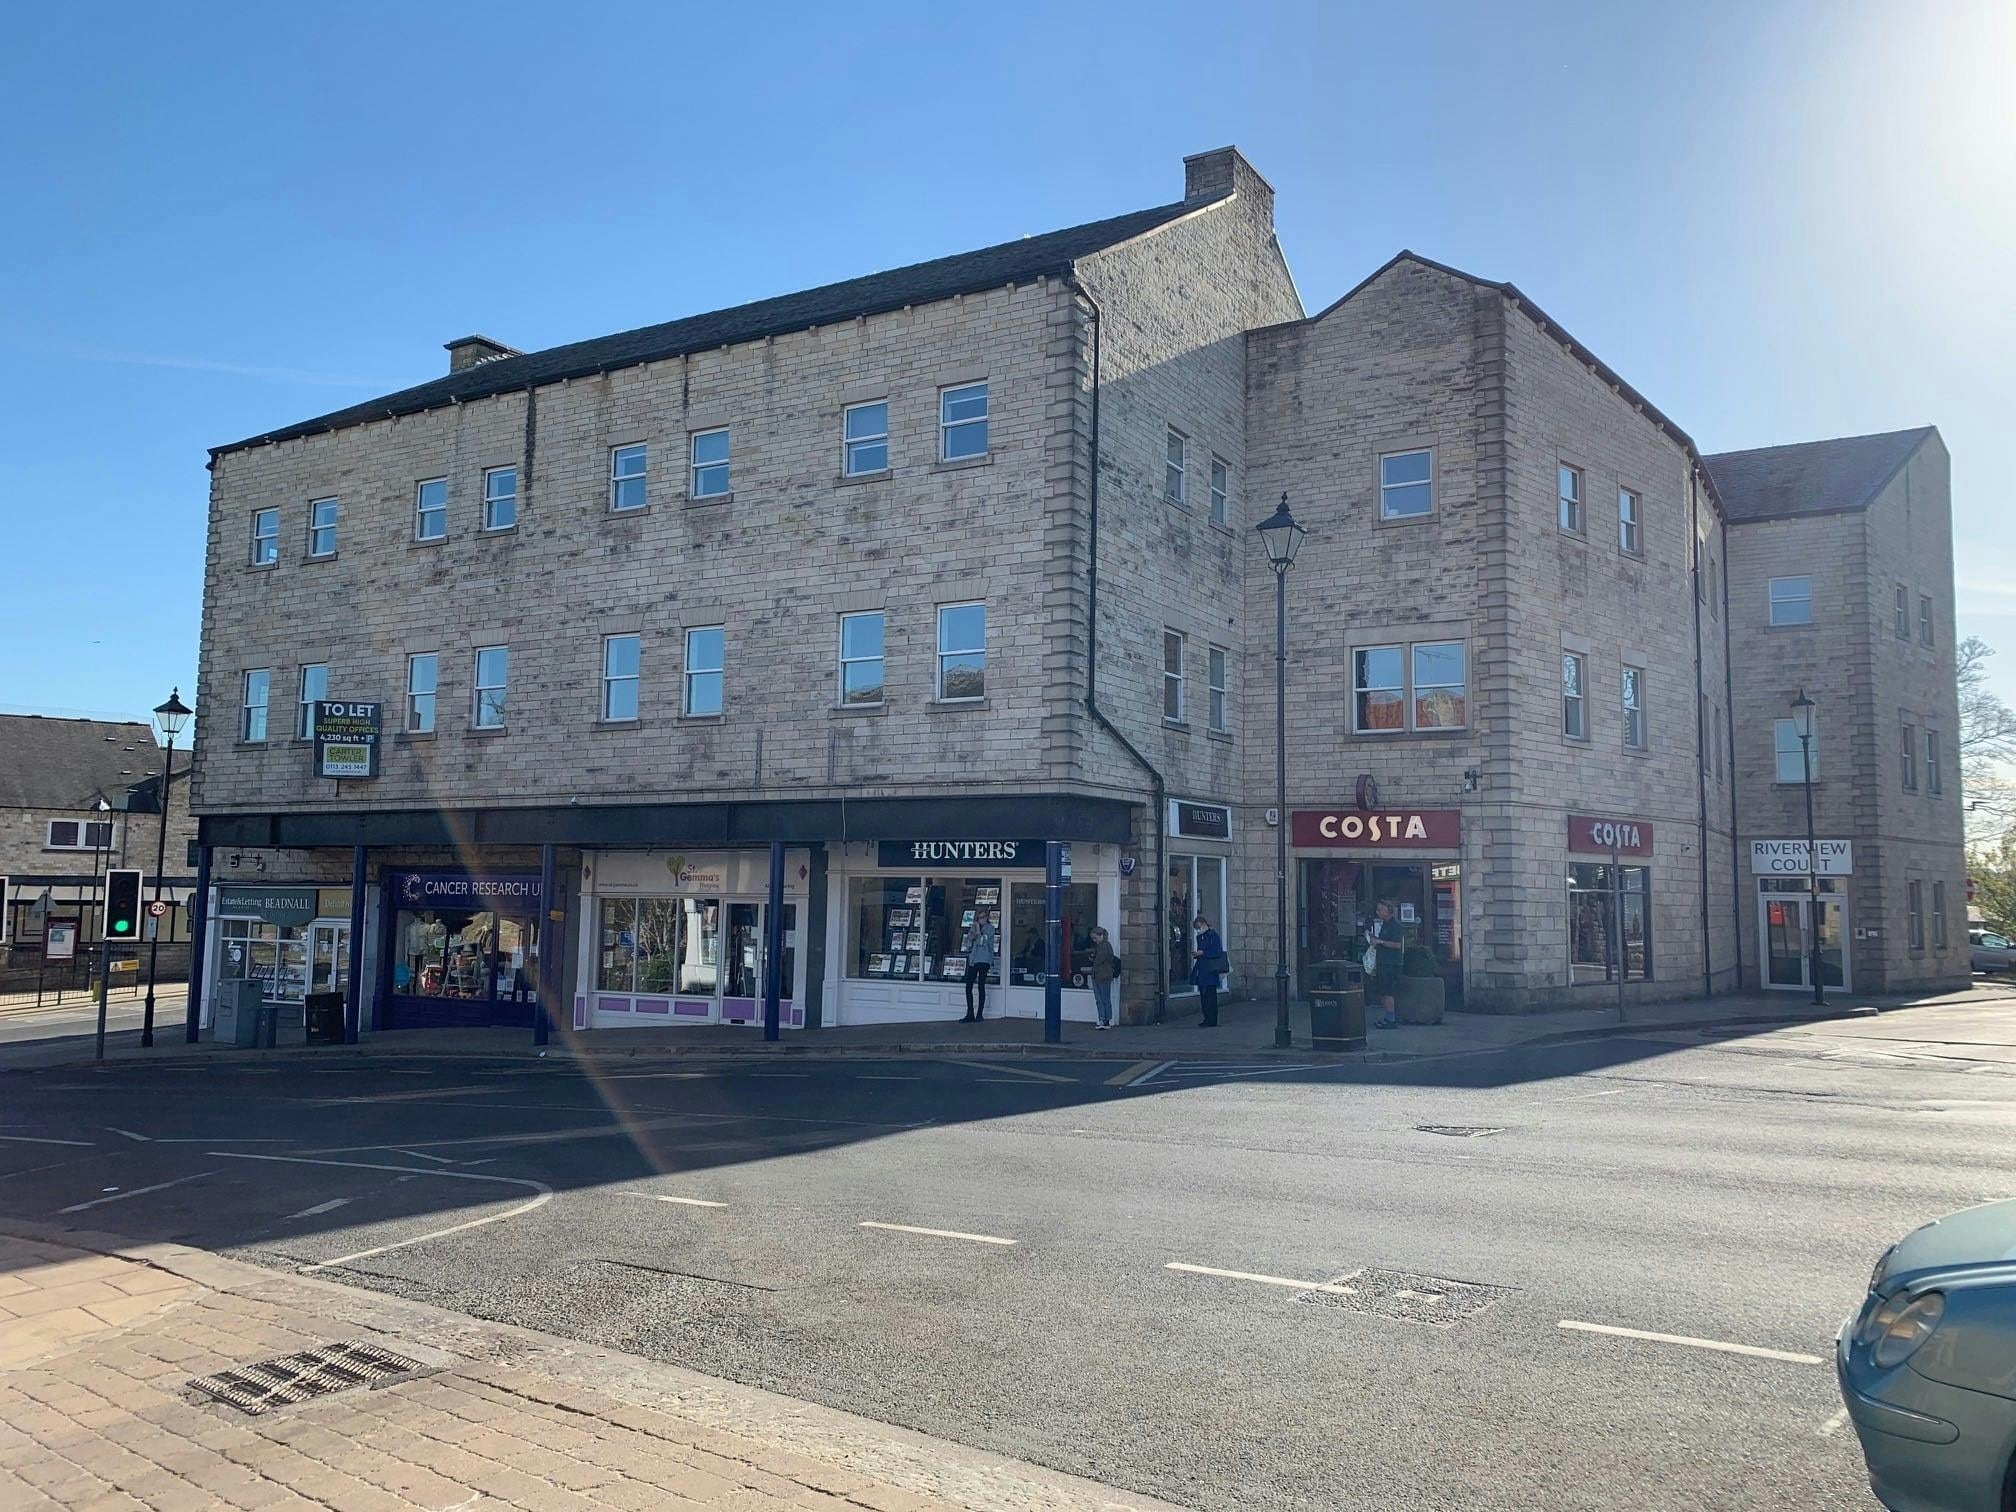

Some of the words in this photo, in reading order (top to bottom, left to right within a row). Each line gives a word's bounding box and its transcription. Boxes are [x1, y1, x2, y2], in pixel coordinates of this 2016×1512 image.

[322, 703, 345, 716] TO
[348, 704, 375, 717] LET
[323, 717, 351, 725] SUPERB
[352, 718, 371, 726] HIGH
[316, 725, 348, 733] QUALITY
[348, 726, 379, 734] OFFICES
[320, 733, 342, 742] 4,230
[352, 734, 359, 742] ft
[1191, 809, 1221, 823] HUNTERS
[1319, 815, 1428, 842] COSTA
[1593, 822, 1640, 849] COSTA
[910, 841, 1017, 859] HUNTERS
[687, 864, 698, 874] St.
[1771, 859, 1831, 871] COUT
[679, 871, 720, 882] Gemma's
[424, 881, 468, 895] CANCER
[471, 882, 528, 896] RESEARCH
[152, 903, 165, 913] 20
[265, 898, 311, 910] BEADNALL
